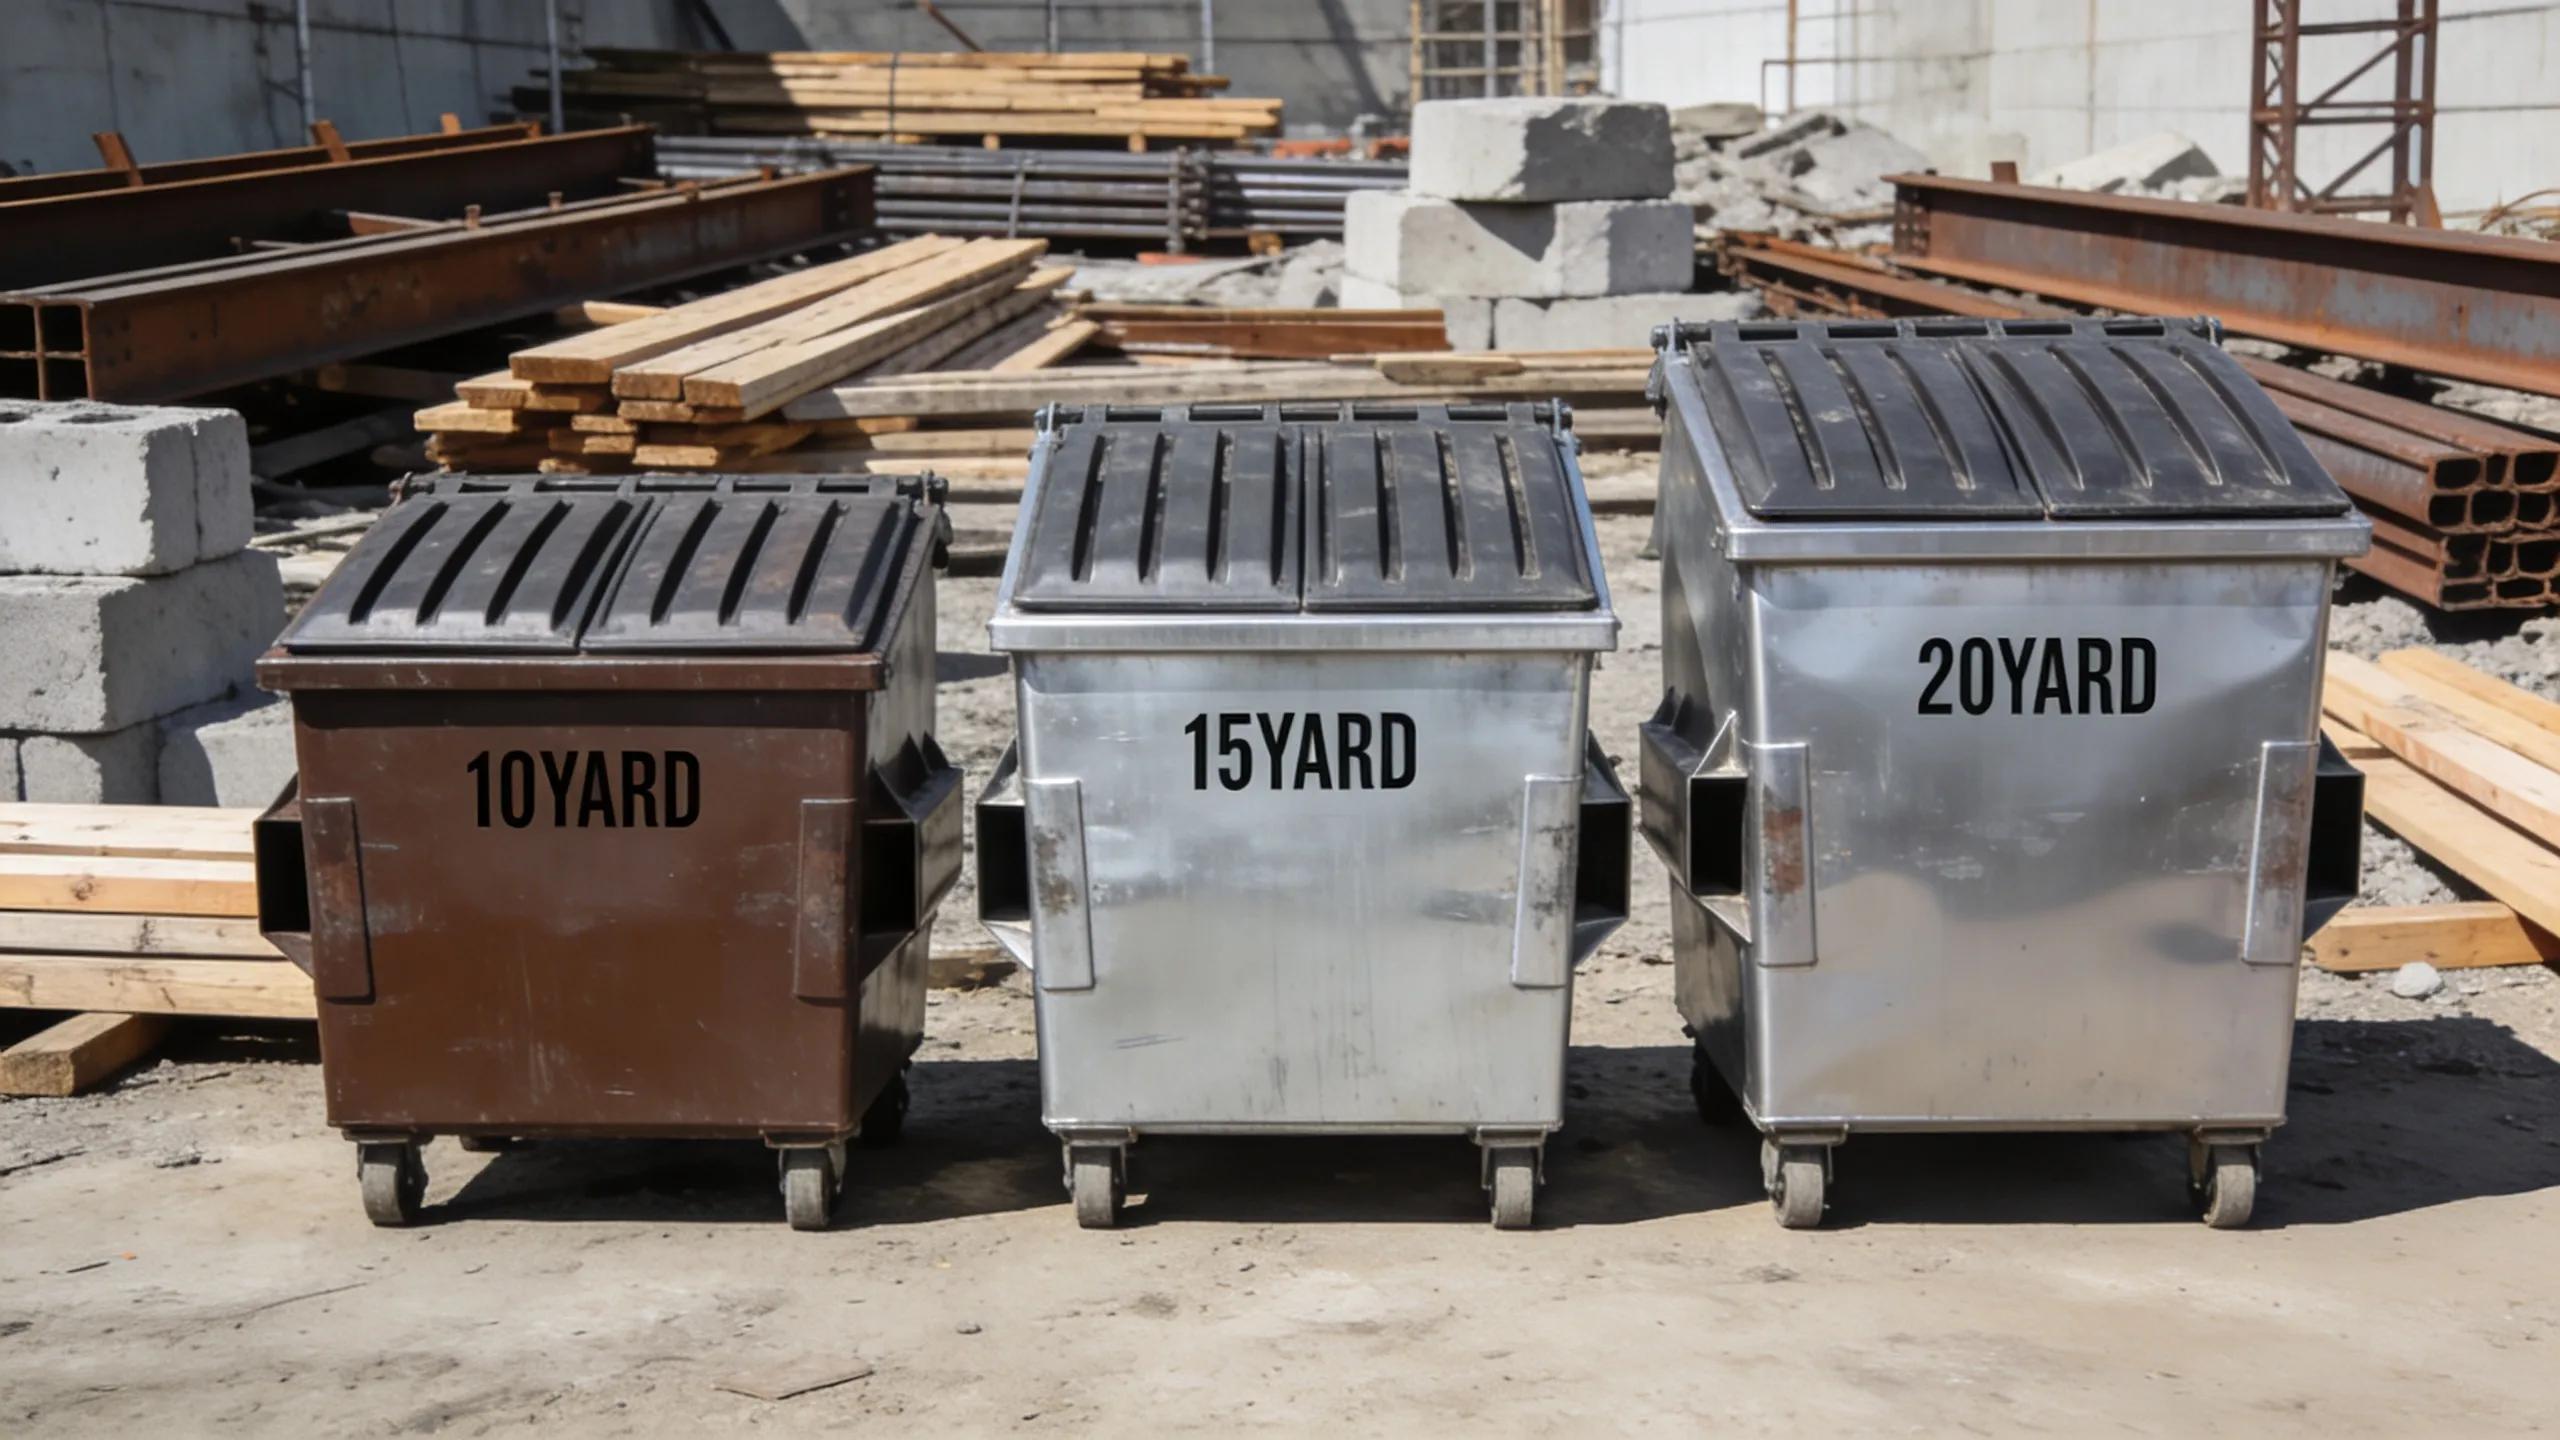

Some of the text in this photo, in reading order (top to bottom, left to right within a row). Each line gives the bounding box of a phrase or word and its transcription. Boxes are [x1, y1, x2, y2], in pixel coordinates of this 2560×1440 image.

[1918, 637, 2157, 715] 20YARD
[467, 750, 700, 828] 10YARD
[1184, 712, 1417, 791] 15YARD
